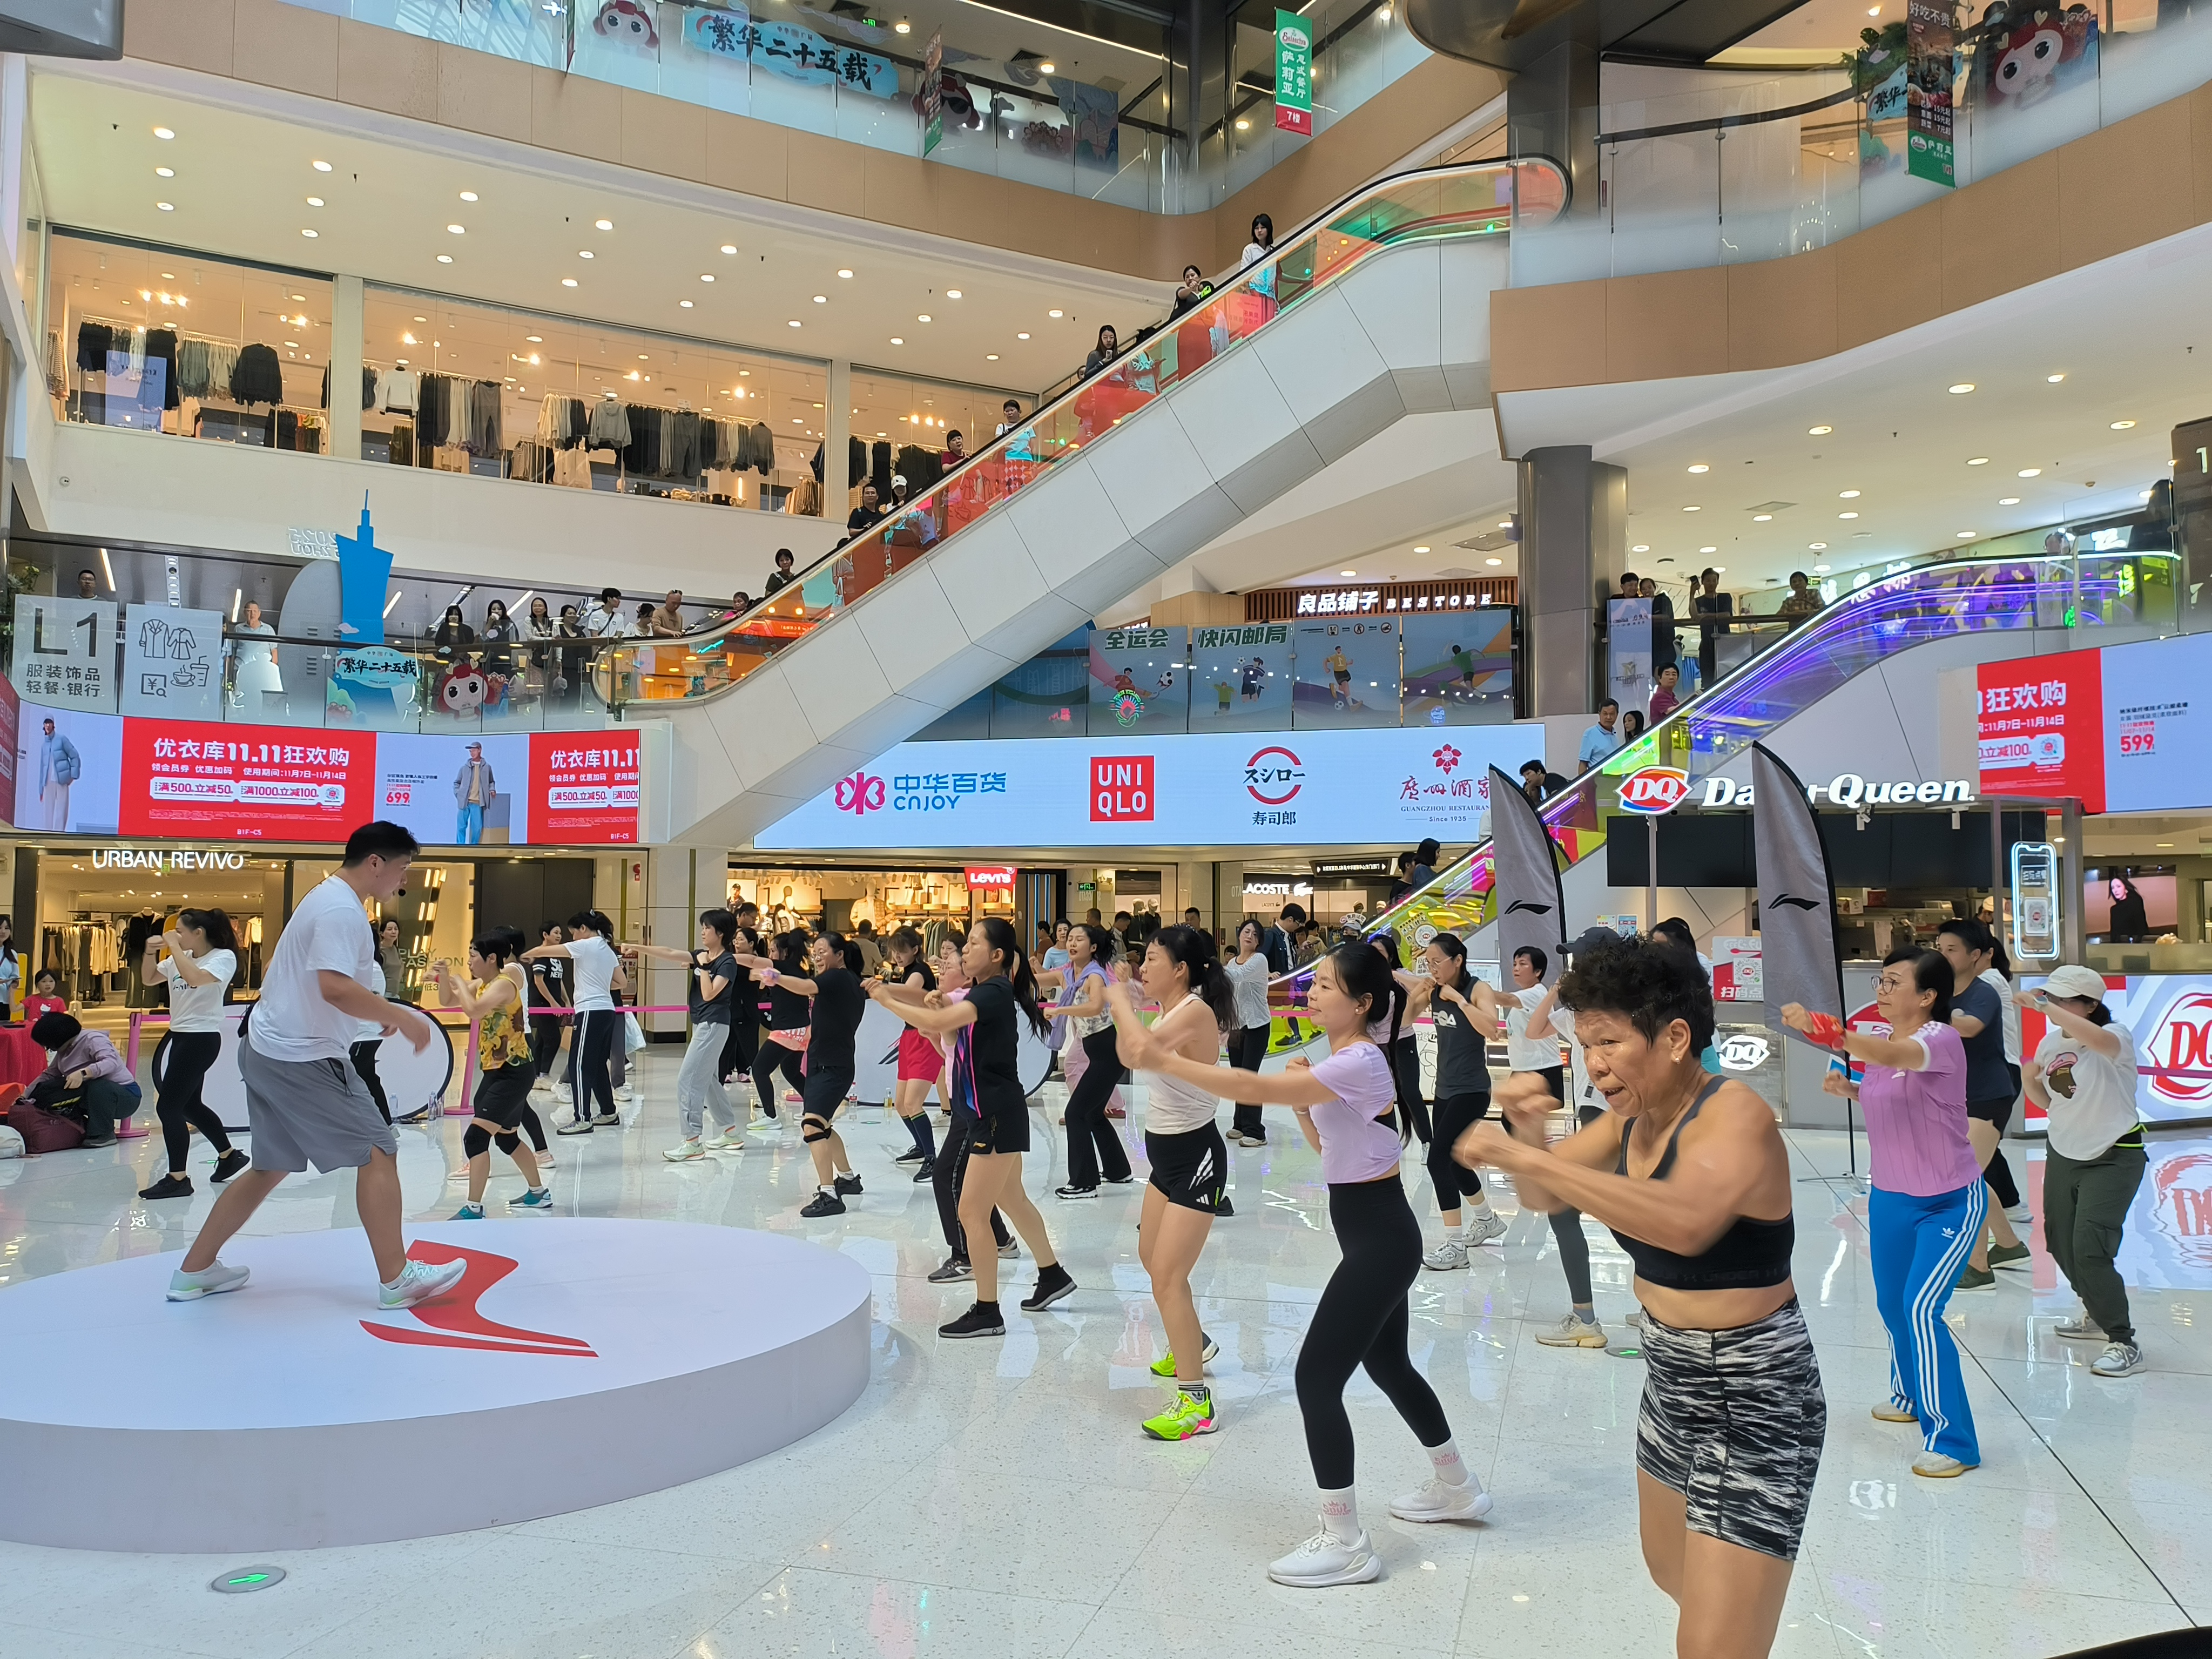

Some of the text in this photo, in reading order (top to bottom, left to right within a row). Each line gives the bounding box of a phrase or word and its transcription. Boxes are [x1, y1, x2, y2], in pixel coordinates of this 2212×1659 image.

[1910, 1, 1950, 28] 好吃不贵
[708, 15, 872, 91] 繁华二十五载
[1281, 50, 1294, 97] 萨莉亚
[1286, 110, 1300, 124] 7楼
[1297, 590, 1492, 614] 良品铺子 BESTORE
[33, 607, 98, 657] L1
[1104, 625, 1288, 650] 全运会 快闪邮局
[26, 664, 101, 683] 服装饰品
[342, 657, 417, 677] 繁华二十五载
[153, 737, 350, 767] 优衣库11.11狂欢购
[2120, 733, 2154, 752] 599
[195, 765, 233, 775] 优惠加码
[1098, 764, 1143, 787] UNI
[1243, 767, 1306, 785] スシロー
[893, 771, 1007, 794] 中华百货
[1631, 778, 1678, 802] DQ
[386, 792, 410, 803] 699
[1097, 791, 1147, 818] QLO
[1252, 811, 1297, 826] 寿司郎
[93, 849, 244, 869] URBAN REVIVO
[399, 949, 437, 959] PLAY
[400, 957, 464, 967] FASHON
[1721, 986, 1763, 999] 扫码点
[1725, 1043, 1759, 1062] DQ
